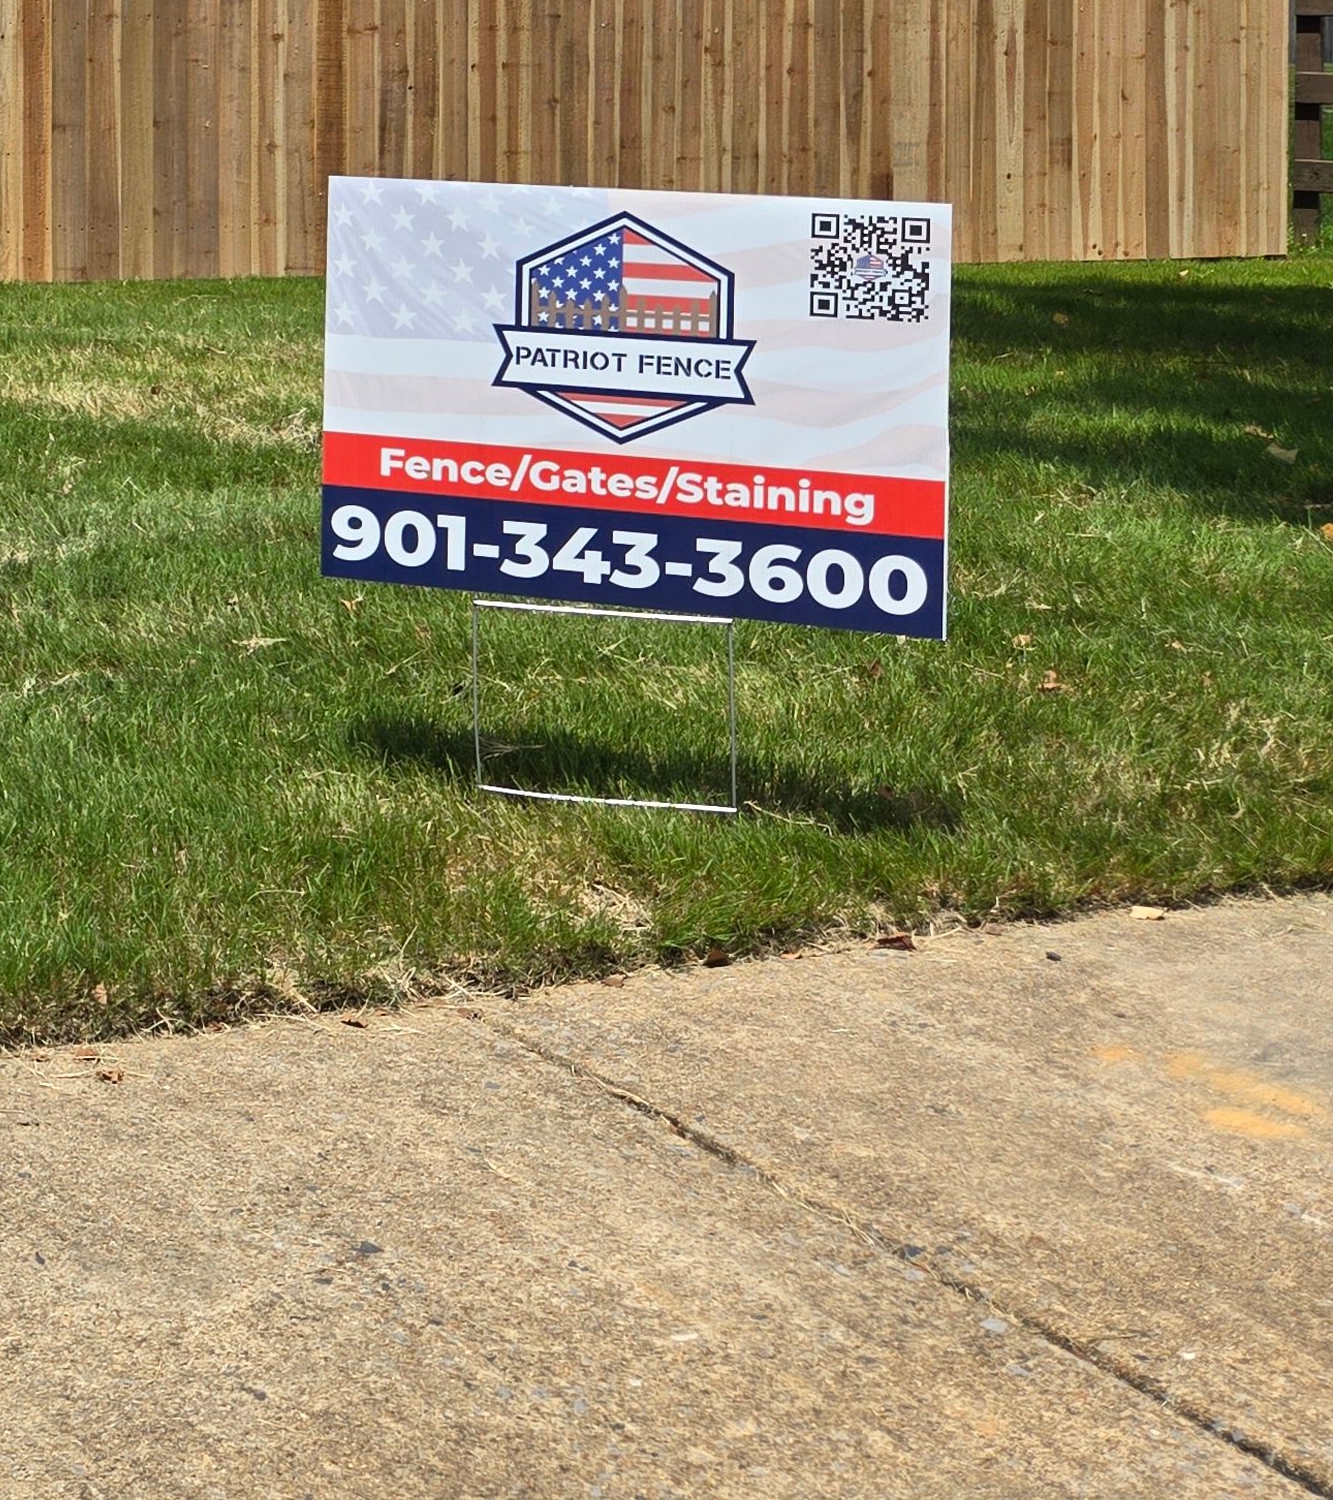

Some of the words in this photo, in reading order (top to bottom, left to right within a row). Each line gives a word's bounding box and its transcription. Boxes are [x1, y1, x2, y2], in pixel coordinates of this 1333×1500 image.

[515, 346, 627, 373] PATRIOT
[638, 353, 732, 380] FENCE
[380, 447, 874, 525] Fence/Gates/Staining
[331, 504, 928, 616] 901-343-3600
